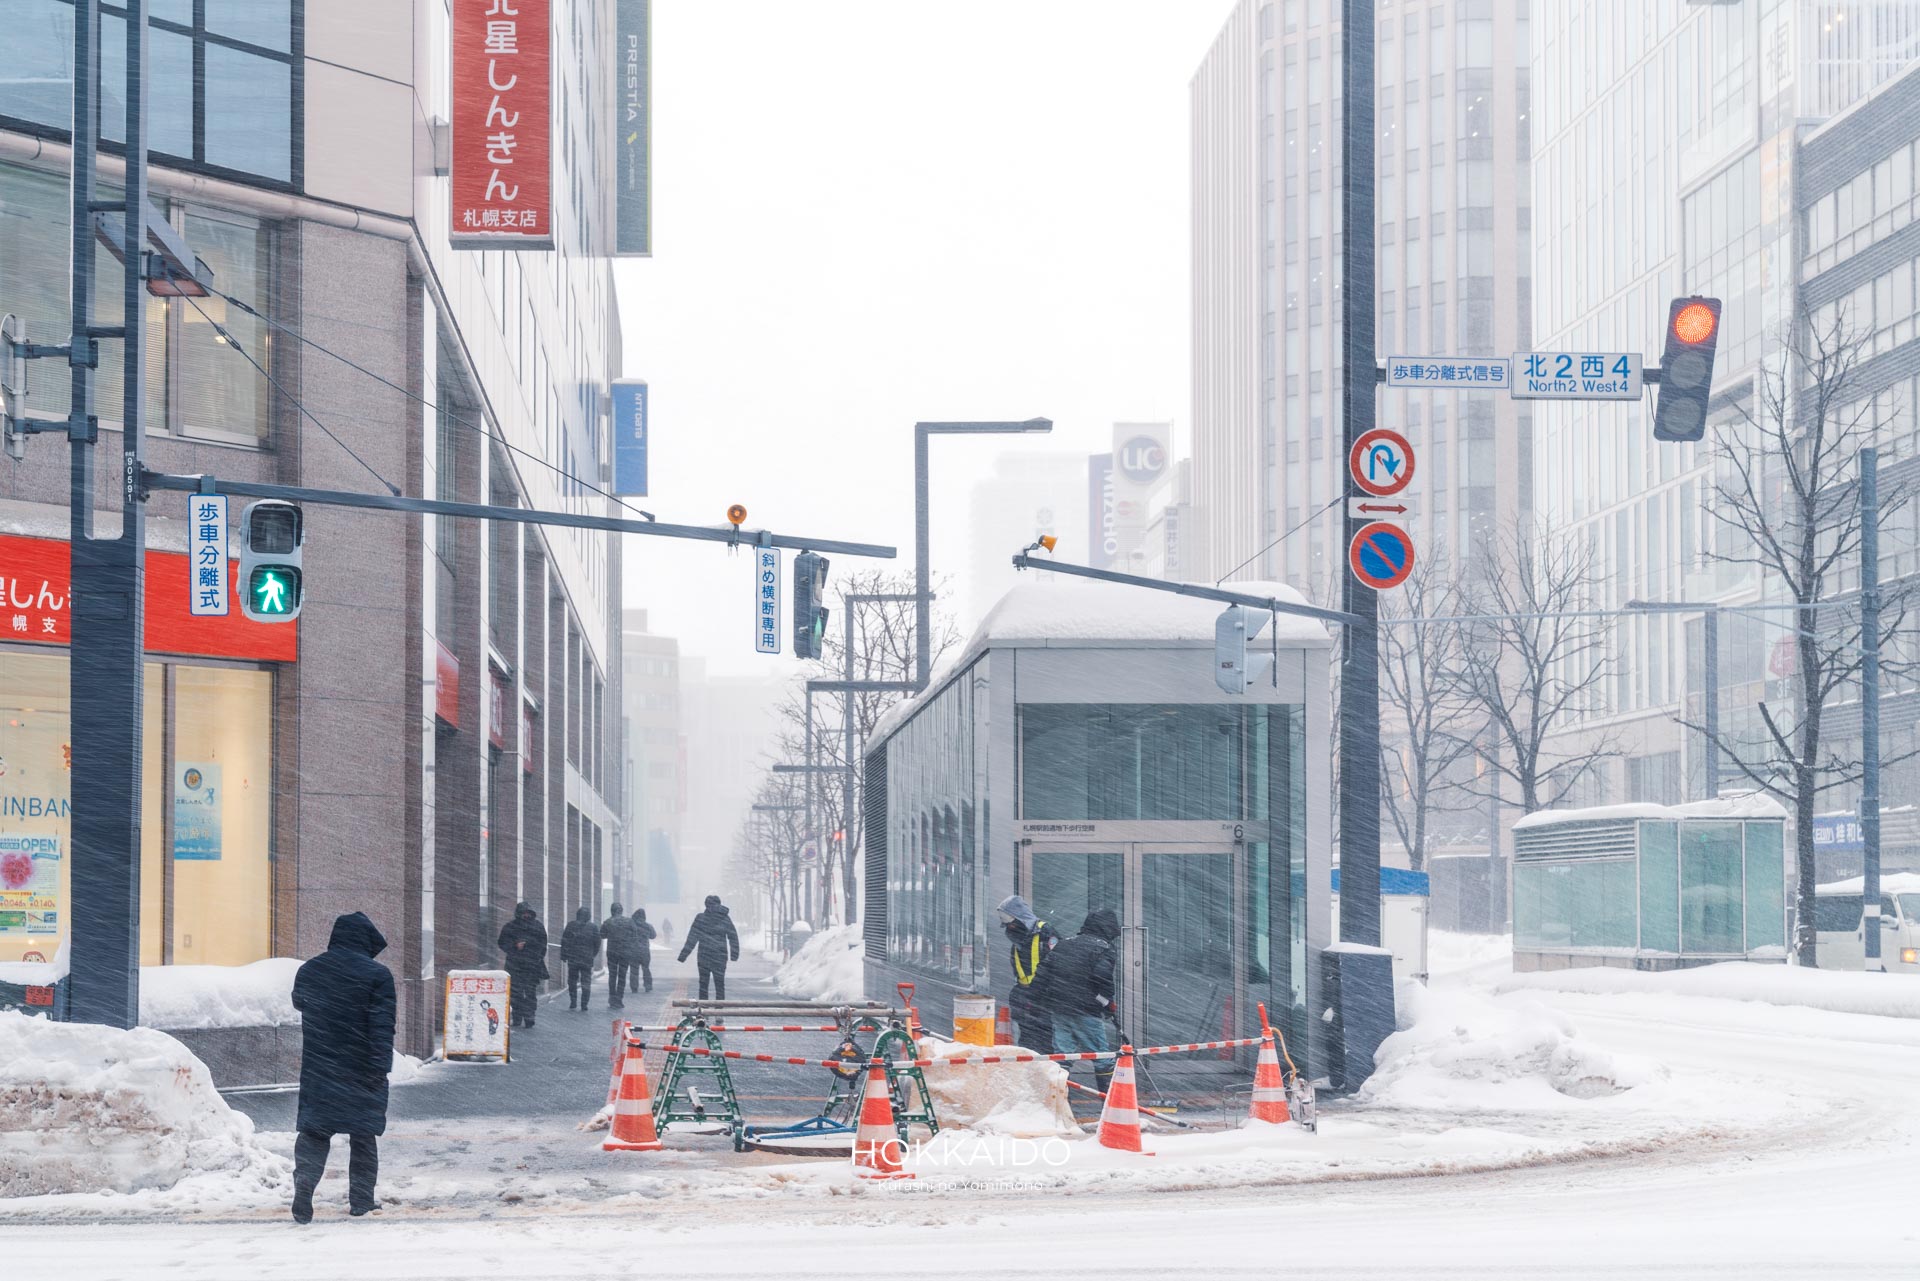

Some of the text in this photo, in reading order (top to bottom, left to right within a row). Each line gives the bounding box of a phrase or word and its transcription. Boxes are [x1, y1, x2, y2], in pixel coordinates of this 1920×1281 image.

[463, 209, 537, 228] 札幌支店
[1393, 365, 1504, 381] 歩車分離式信号
[1122, 447, 1164, 470] UC
[198, 502, 220, 609] 歩車分離式
[0, 577, 71, 611] しん
[761, 553, 775, 648] 斜め横断専用
[1233, 824, 1244, 839] 6
[21, 838, 57, 852] OPEN
